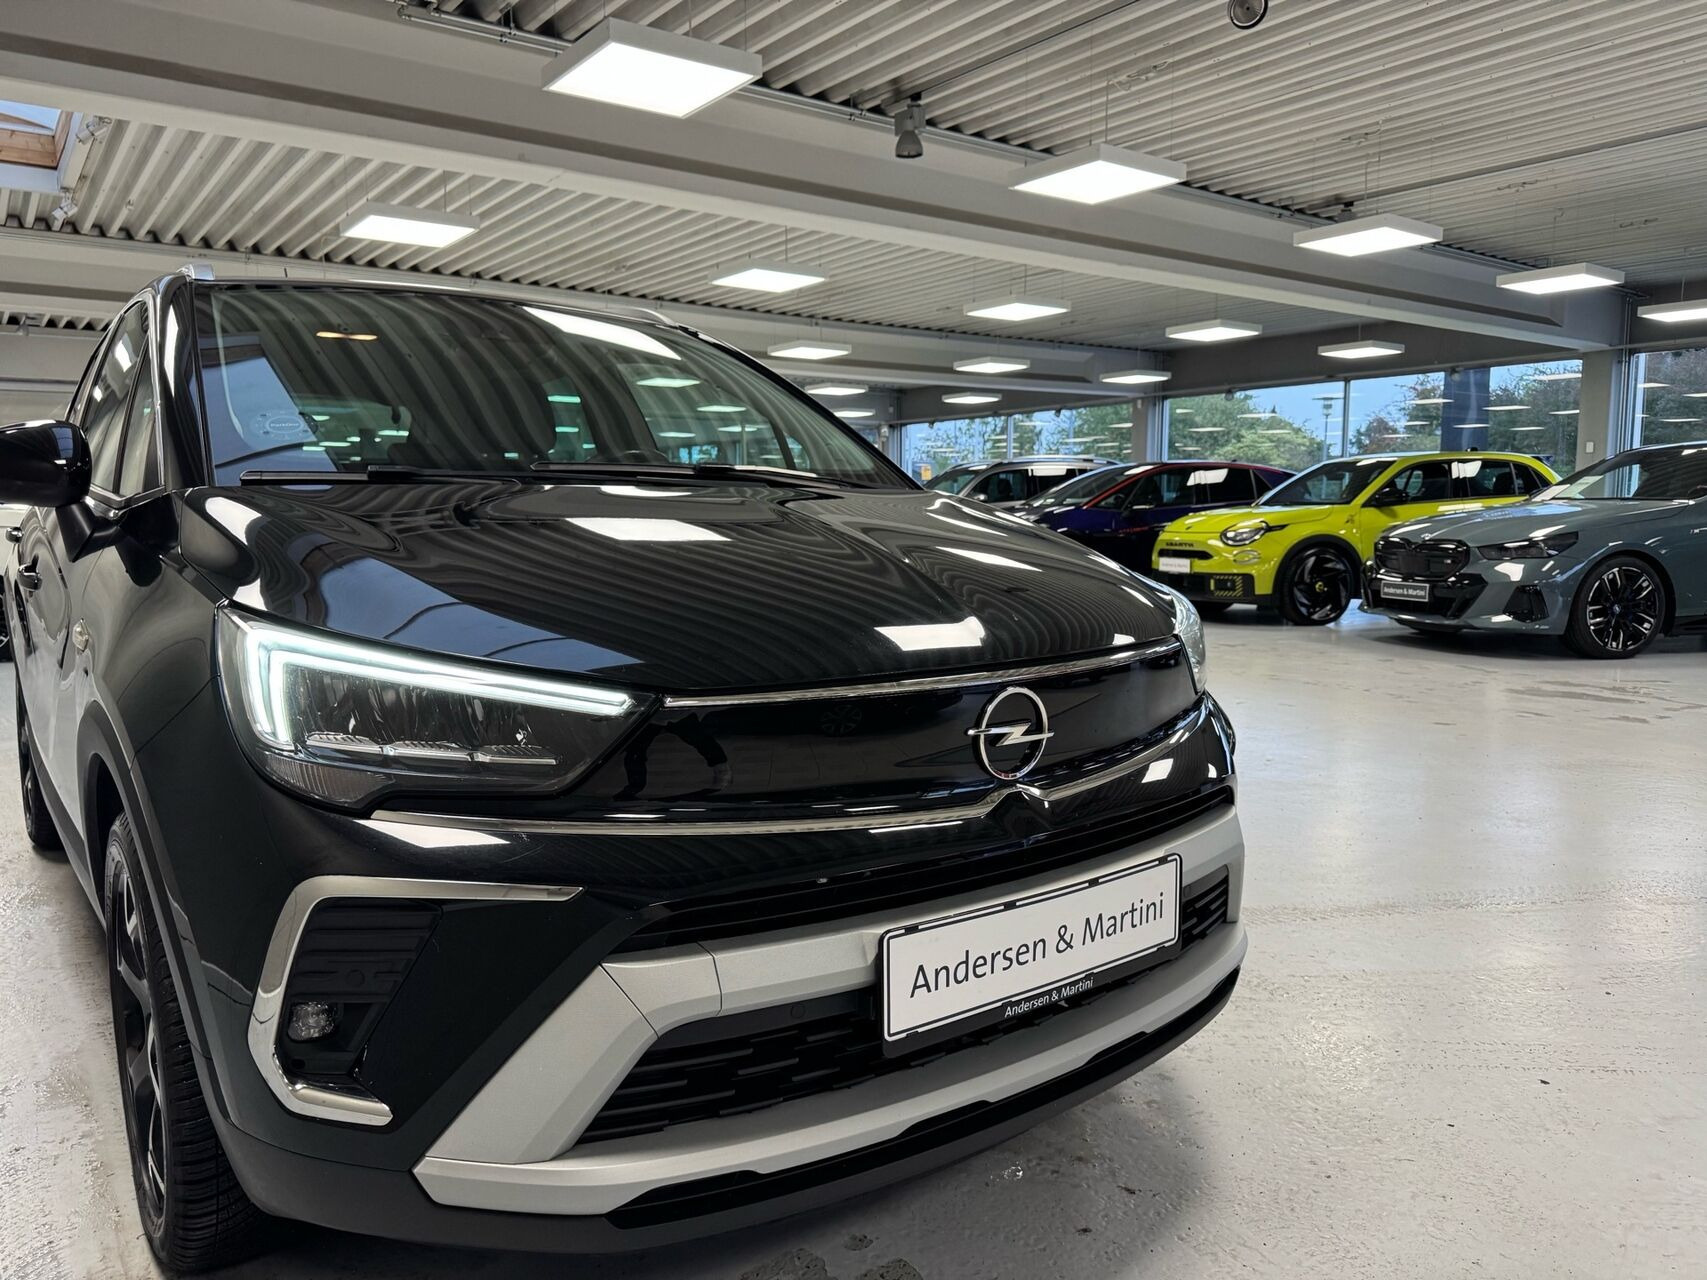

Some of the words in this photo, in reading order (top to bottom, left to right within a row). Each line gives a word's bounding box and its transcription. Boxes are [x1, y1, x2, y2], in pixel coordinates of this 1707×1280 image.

[1384, 586, 1403, 595] Andersen
[1408, 588, 1426, 596] Martini
[909, 936, 1046, 998] Andersen
[1055, 925, 1074, 953] &
[1082, 891, 1164, 945] Martini
[1004, 995, 1049, 1018] Andersen
[1051, 990, 1059, 1001] &
[1060, 977, 1094, 998] Martini
